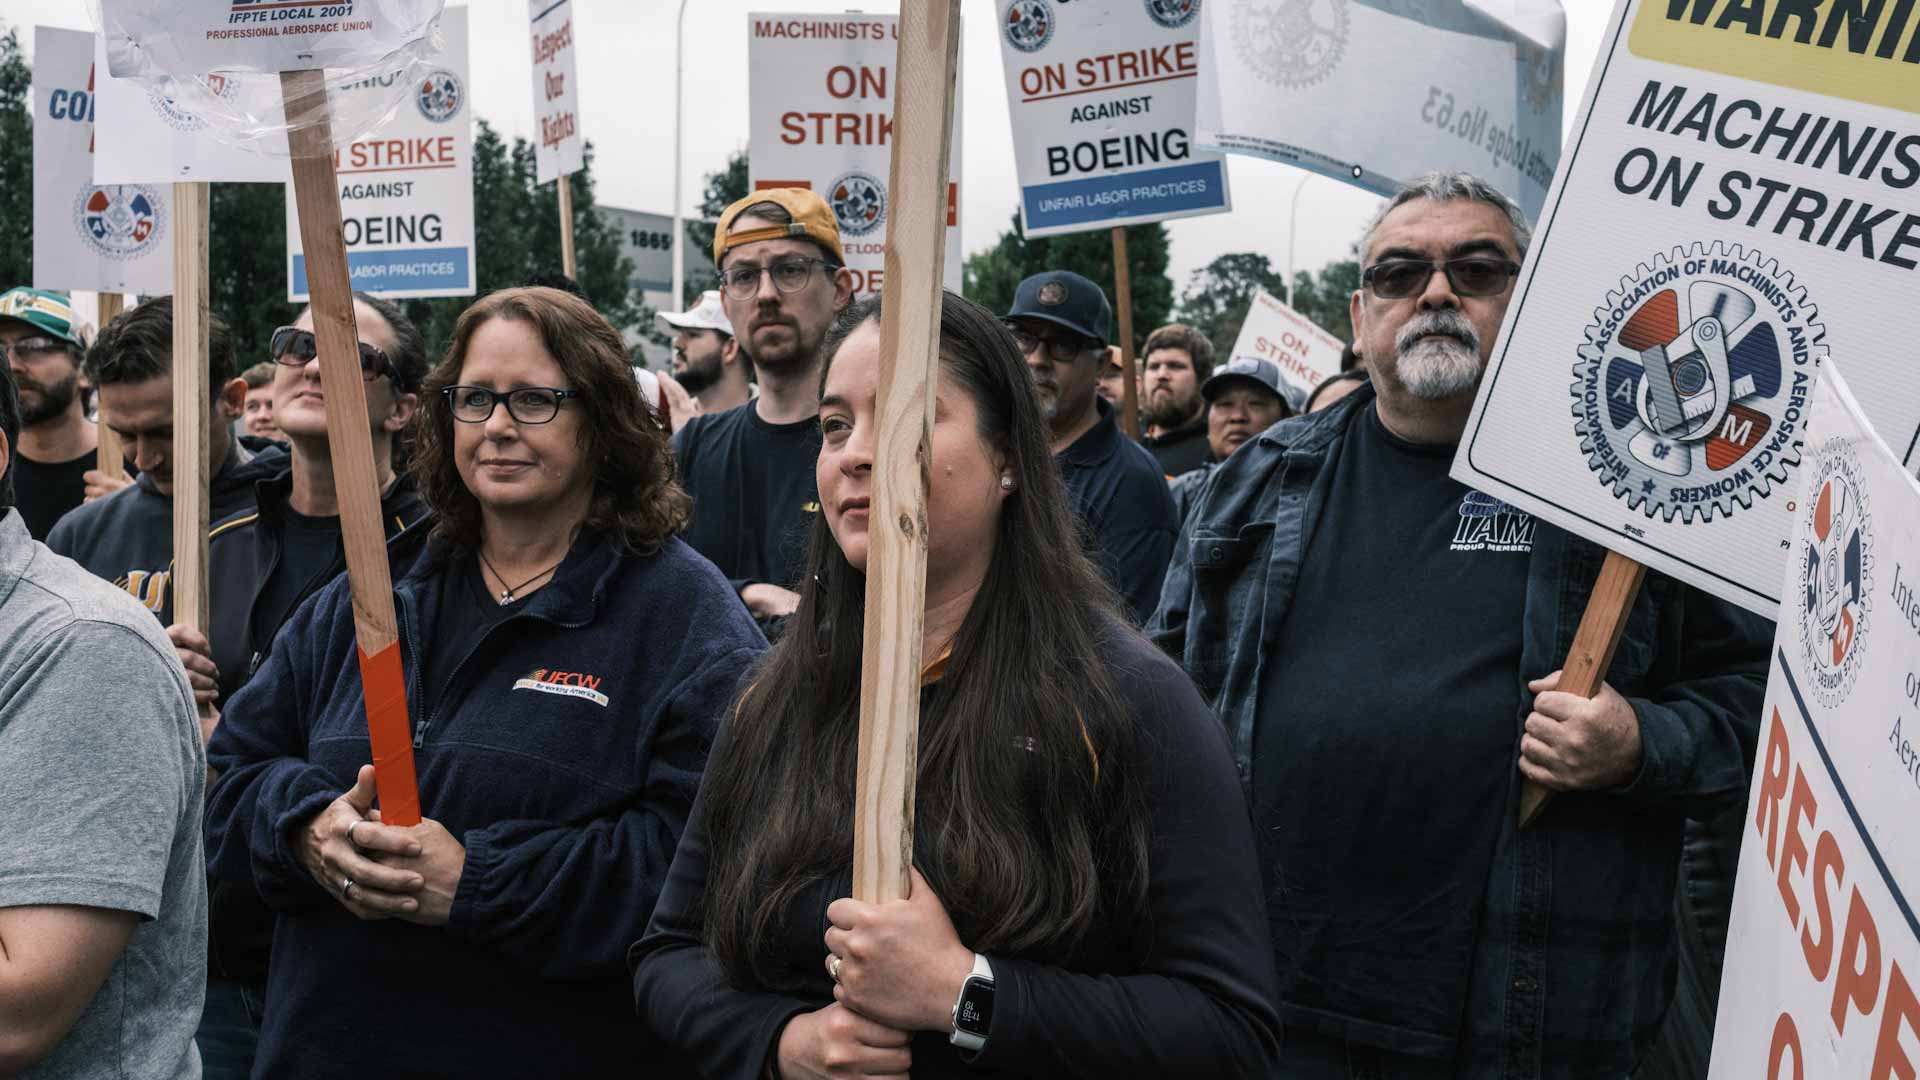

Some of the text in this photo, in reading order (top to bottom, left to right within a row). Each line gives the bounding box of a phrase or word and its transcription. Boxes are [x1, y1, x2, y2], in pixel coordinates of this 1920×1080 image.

[206, 21, 373, 39] PROFESSIONAL AEROSPACE UNION
[229, 6, 353, 23] IFPTE LOCAL 2001
[755, 21, 884, 40] MACHINISTS
[533, 20, 572, 64] Respect
[1664, 0, 1920, 64] ARNI
[826, 66, 886, 99] ON
[1020, 41, 1197, 96] ON STRIKE
[1070, 96, 1153, 123] AGAINST
[542, 112, 574, 151] Rights
[780, 112, 894, 146] STRIK
[1627, 80, 1920, 188] MACHINIS
[351, 137, 455, 167] STRIKE
[1047, 128, 1189, 177] BOEING
[342, 182, 414, 200] AGAINST
[1038, 179, 1207, 213] UNFAIR LABOR PRACTICES
[1614, 147, 1704, 207] ON
[1707, 170, 1920, 270] STRIKE
[343, 213, 443, 246] OEING
[856, 243, 888, 254] LOD
[349, 261, 455, 279] LABOR PRACTICES
[1281, 331, 1310, 357] ON
[1254, 336, 1322, 388] STRIKE
[1585, 259, 1809, 503] INTERNATIONAL ASSOCIATION OF MACHINISTS AND AEROSPACE WORKERS
[1720, 414, 1753, 446] M
[1453, 512, 1537, 545] IAM
[1450, 543, 1532, 553] PROUD MEMBER
[1891, 563, 1920, 635] Inte
[537, 668, 600, 690] UFCW
